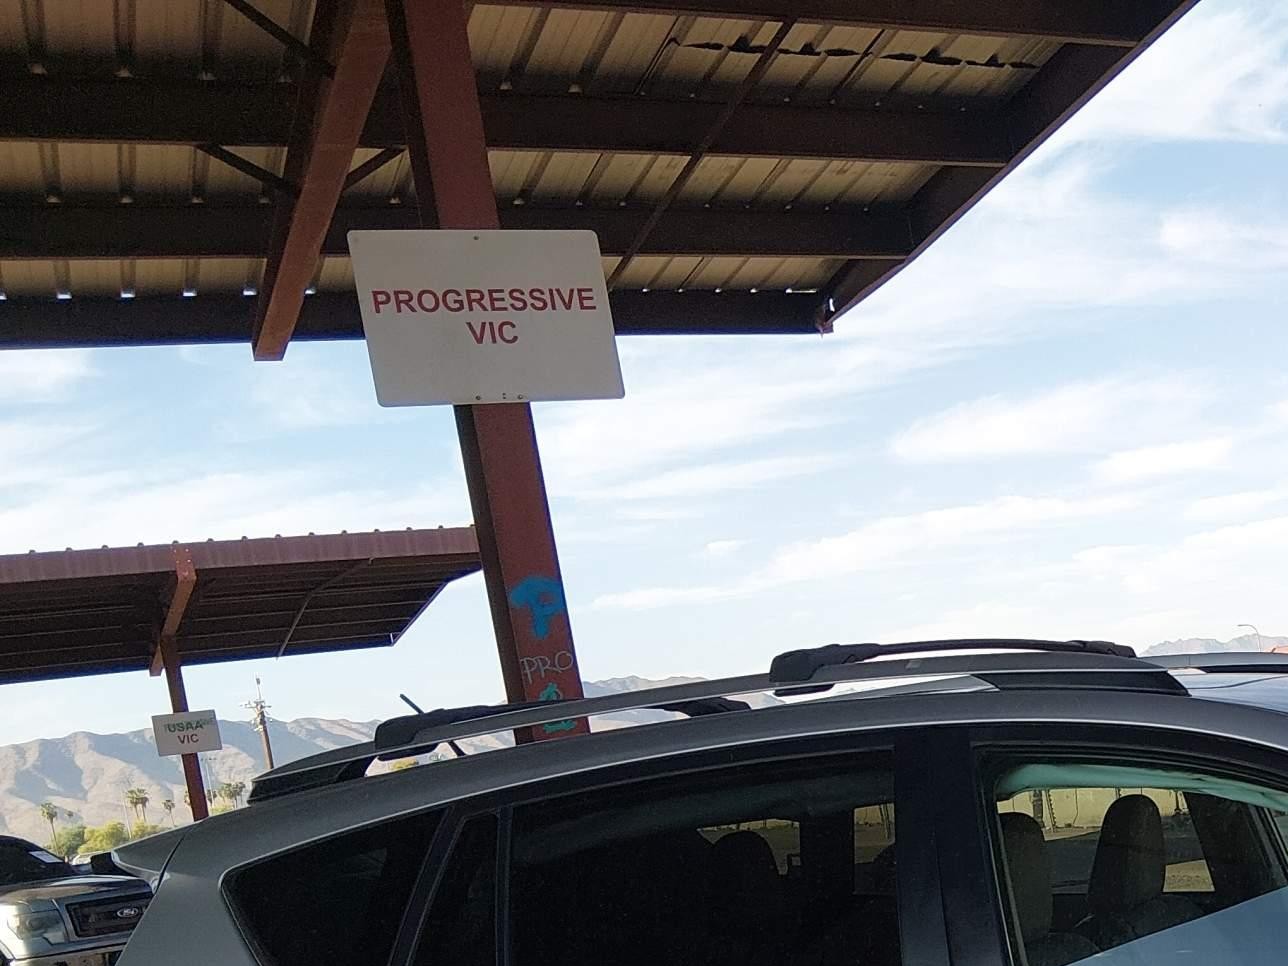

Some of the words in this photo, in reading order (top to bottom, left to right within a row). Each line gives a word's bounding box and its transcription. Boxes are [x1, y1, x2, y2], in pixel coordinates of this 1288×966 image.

[371, 287, 597, 314] PROGRESSIVE
[466, 321, 519, 345] VIC
[519, 650, 574, 684] PRO
[167, 720, 205, 733] USAA
[177, 733, 200, 745] VIC
